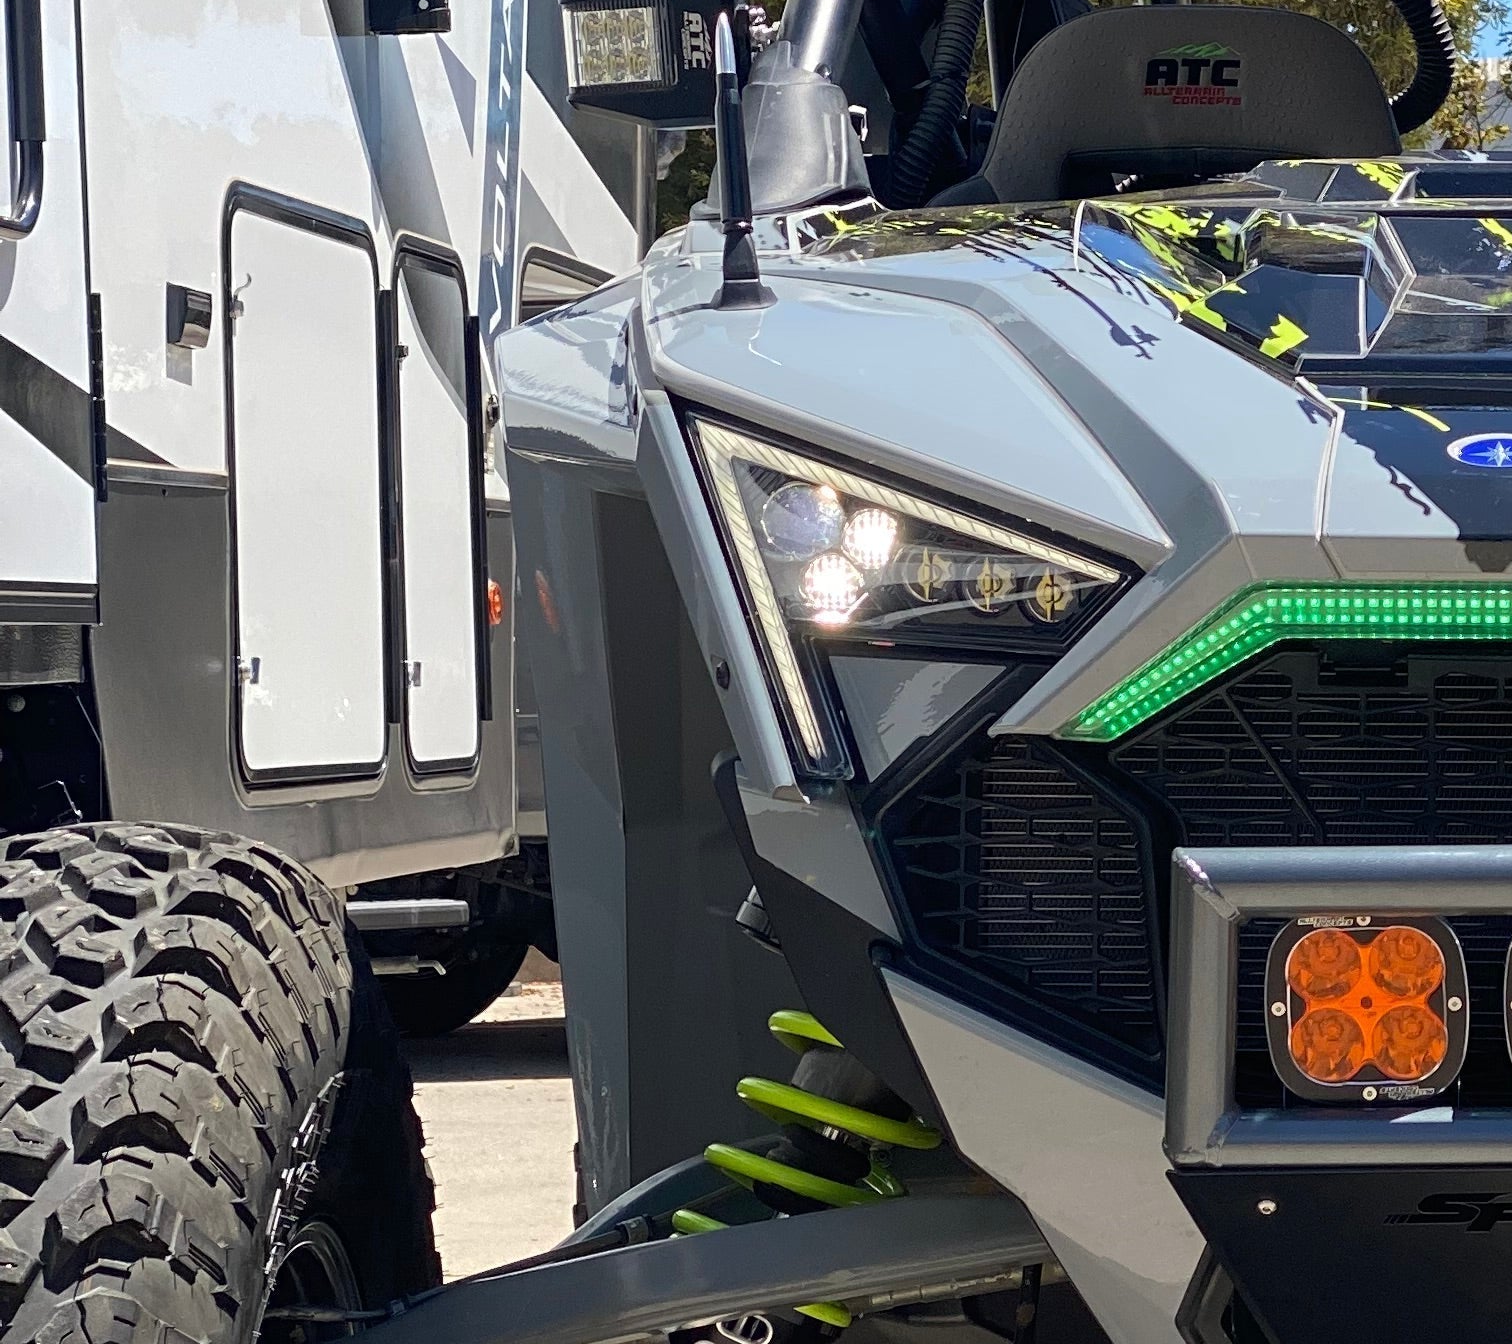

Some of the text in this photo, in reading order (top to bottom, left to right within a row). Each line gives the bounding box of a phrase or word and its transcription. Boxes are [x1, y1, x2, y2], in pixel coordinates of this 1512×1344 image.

[689, 11, 707, 70] ATC
[1145, 58, 1241, 87] ATC
[1171, 95, 1242, 105] CONCEPTS
